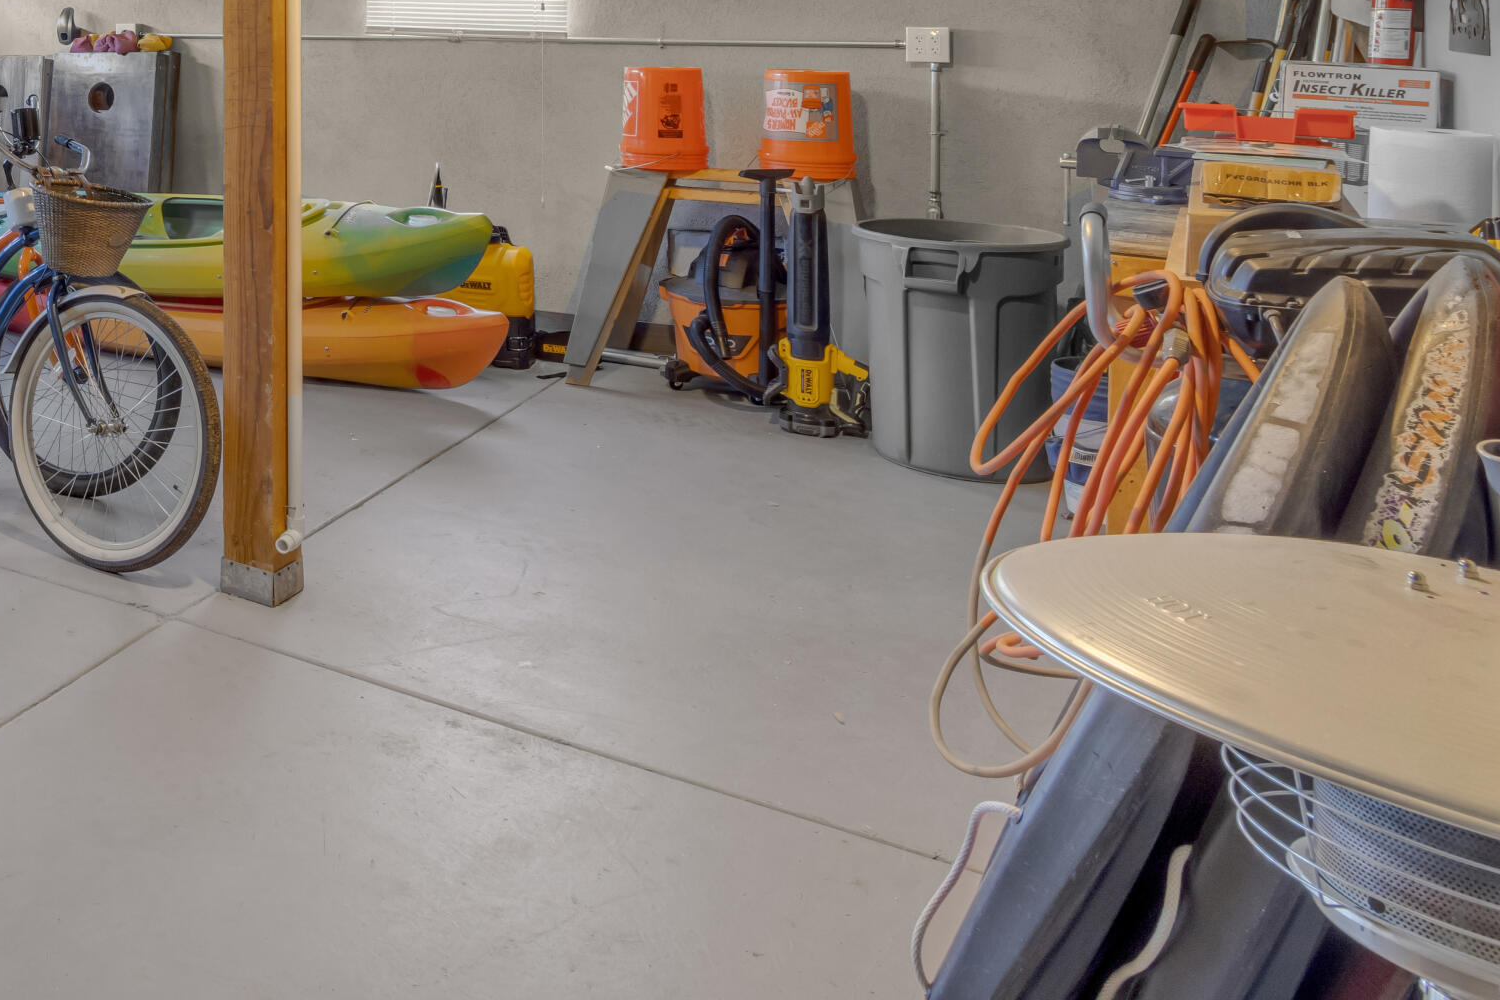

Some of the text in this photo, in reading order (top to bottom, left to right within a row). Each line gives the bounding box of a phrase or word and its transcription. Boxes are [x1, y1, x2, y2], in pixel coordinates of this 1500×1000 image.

[1293, 70, 1362, 81] FLOWTRON
[1293, 79, 1347, 96] INSECT
[1350, 82, 1406, 99] KILLER
